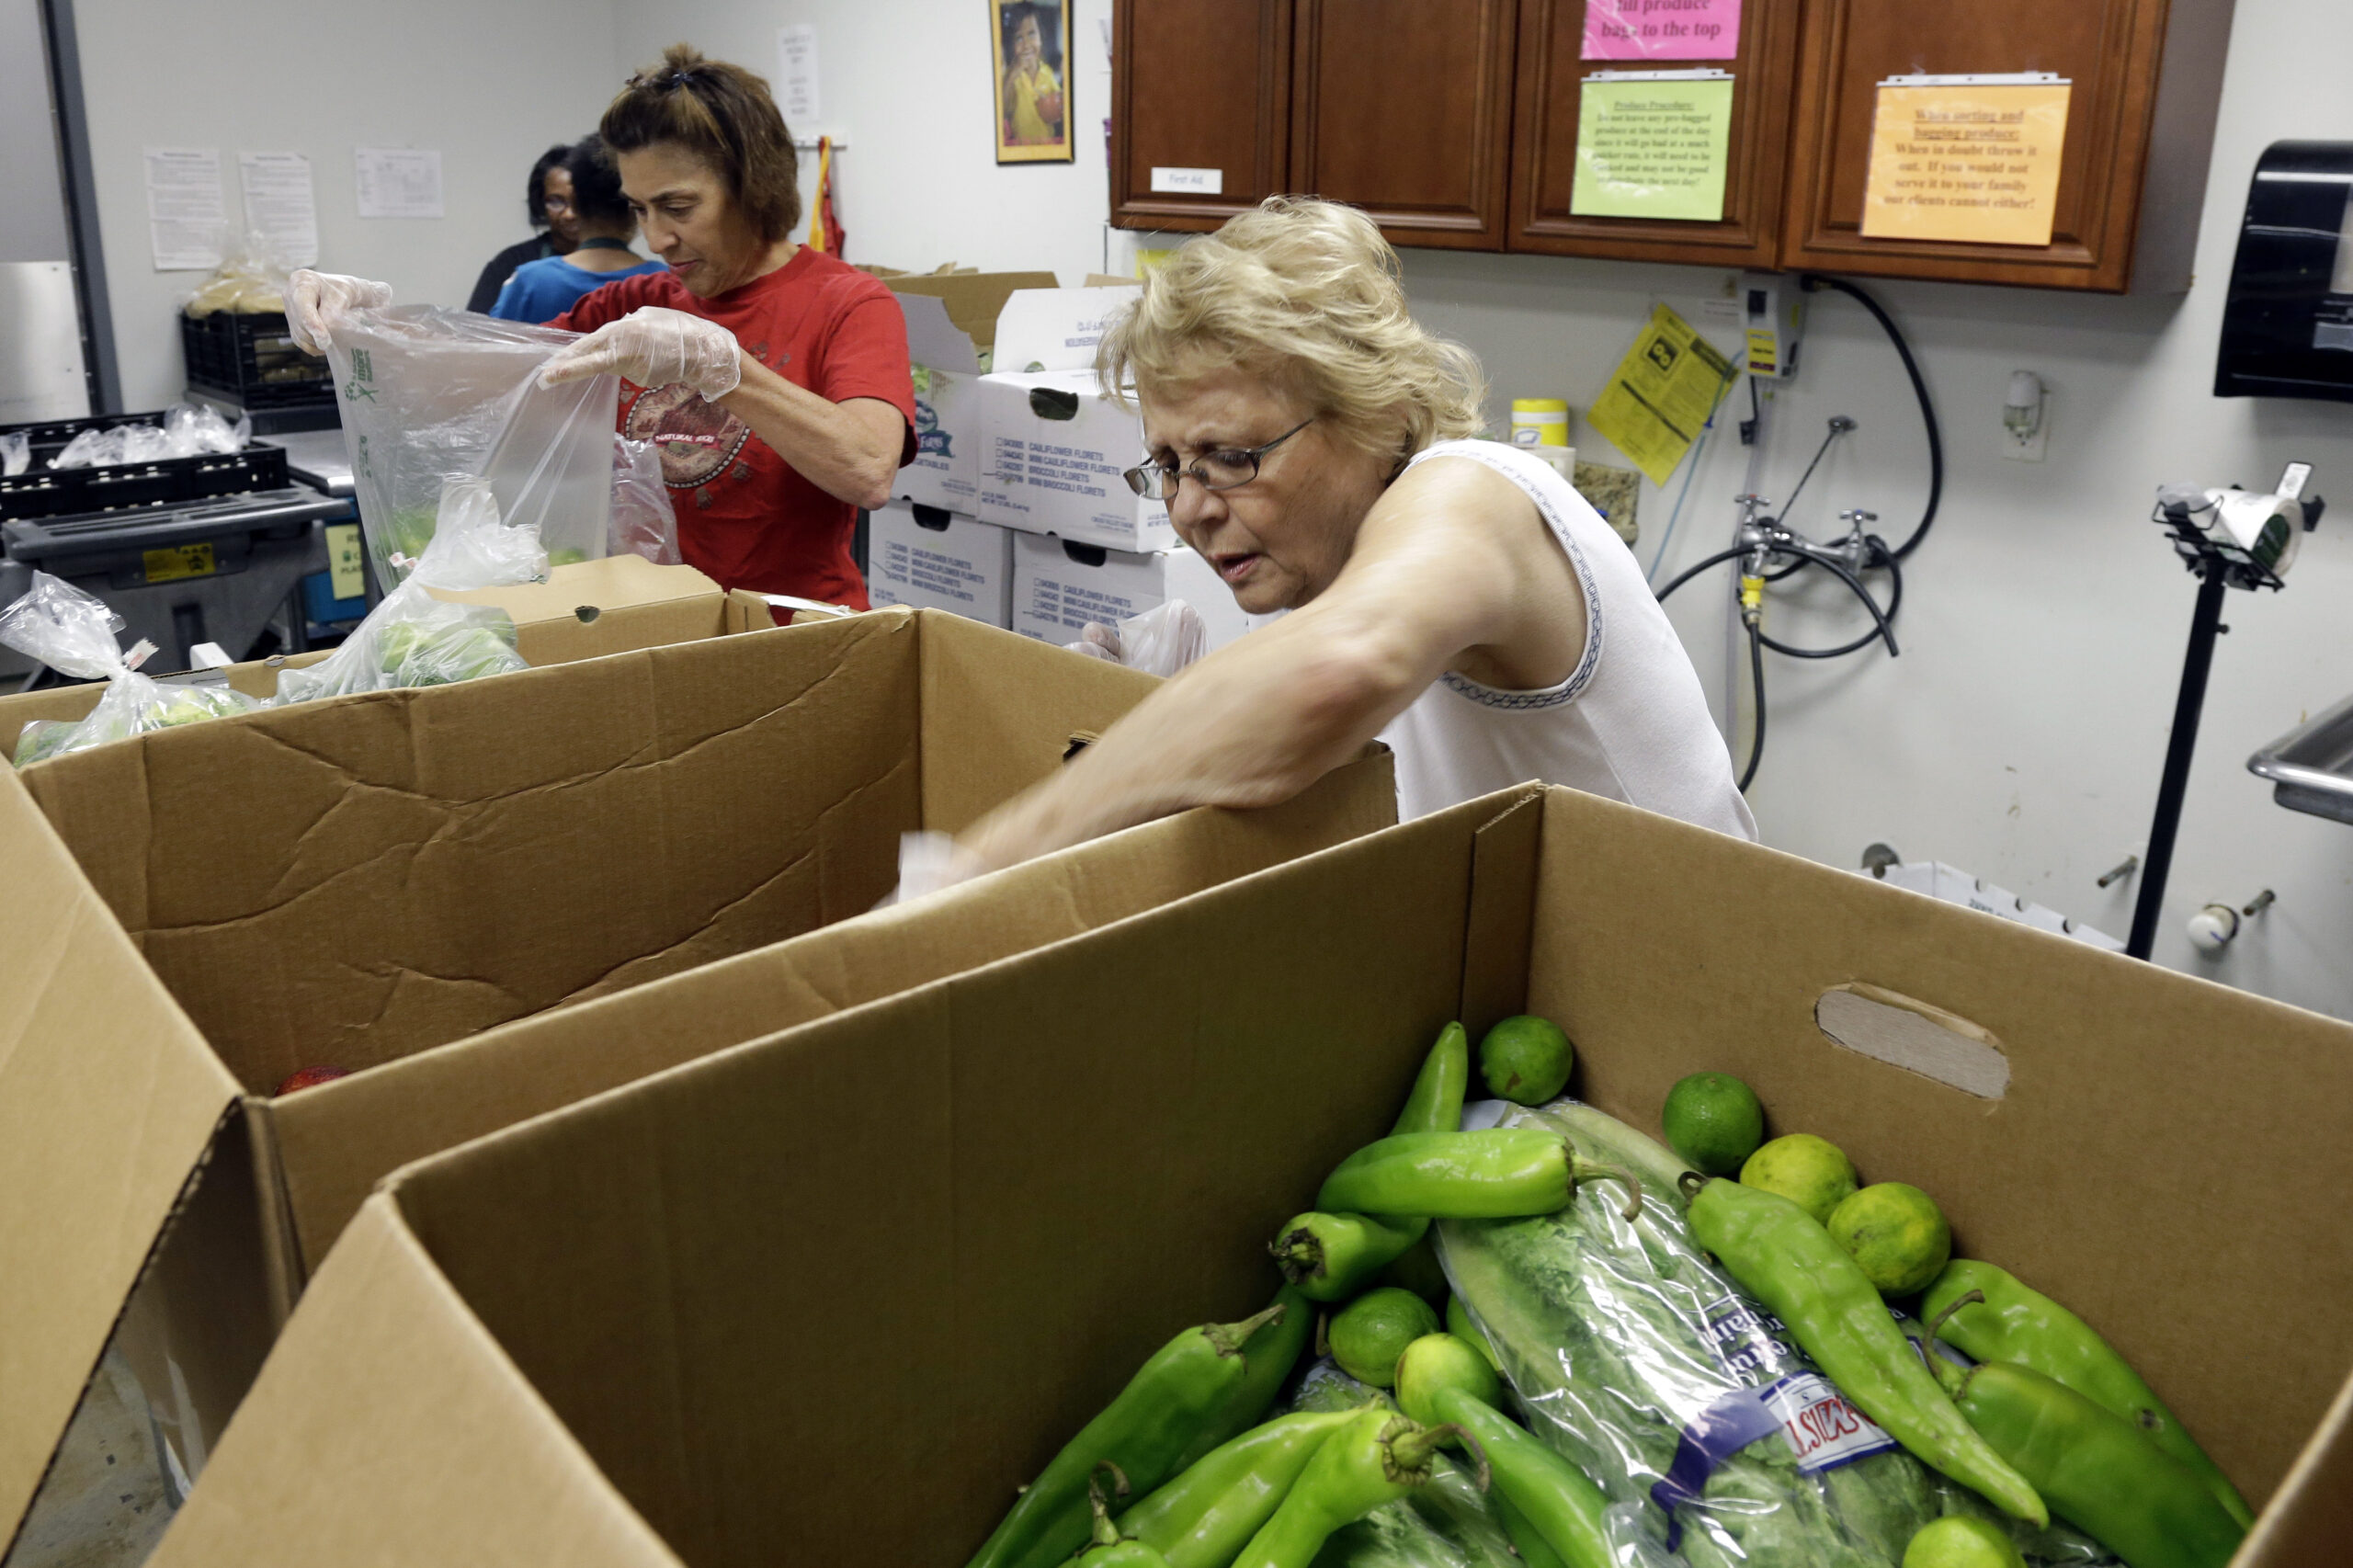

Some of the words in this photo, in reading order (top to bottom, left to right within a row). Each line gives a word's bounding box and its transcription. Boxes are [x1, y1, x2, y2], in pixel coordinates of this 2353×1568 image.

[1643, 0, 1711, 16] produce
[1643, 24, 1658, 37] to
[1663, 20, 1689, 37] the
[1695, 23, 1722, 40] top
[1895, 143, 1929, 154] When
[1933, 143, 1945, 154] in
[1949, 143, 1984, 155] doubt
[1169, 174, 1188, 184] First
[2008, 165, 2029, 174] not
[1029, 442, 1073, 456] CAULIFLOWER
[1074, 449, 1104, 462] FLORETS
[1029, 465, 1059, 478] BROCCOLI
[1060, 471, 1090, 483] FLORETS
[1043, 456, 1089, 472] CAULIFLOWER
[1090, 463, 1120, 476] FLORETS
[1043, 478, 1075, 492] BROCCOLI
[1076, 484, 1107, 498] FLORETS
[1786, 1394, 1859, 1460] MIST
